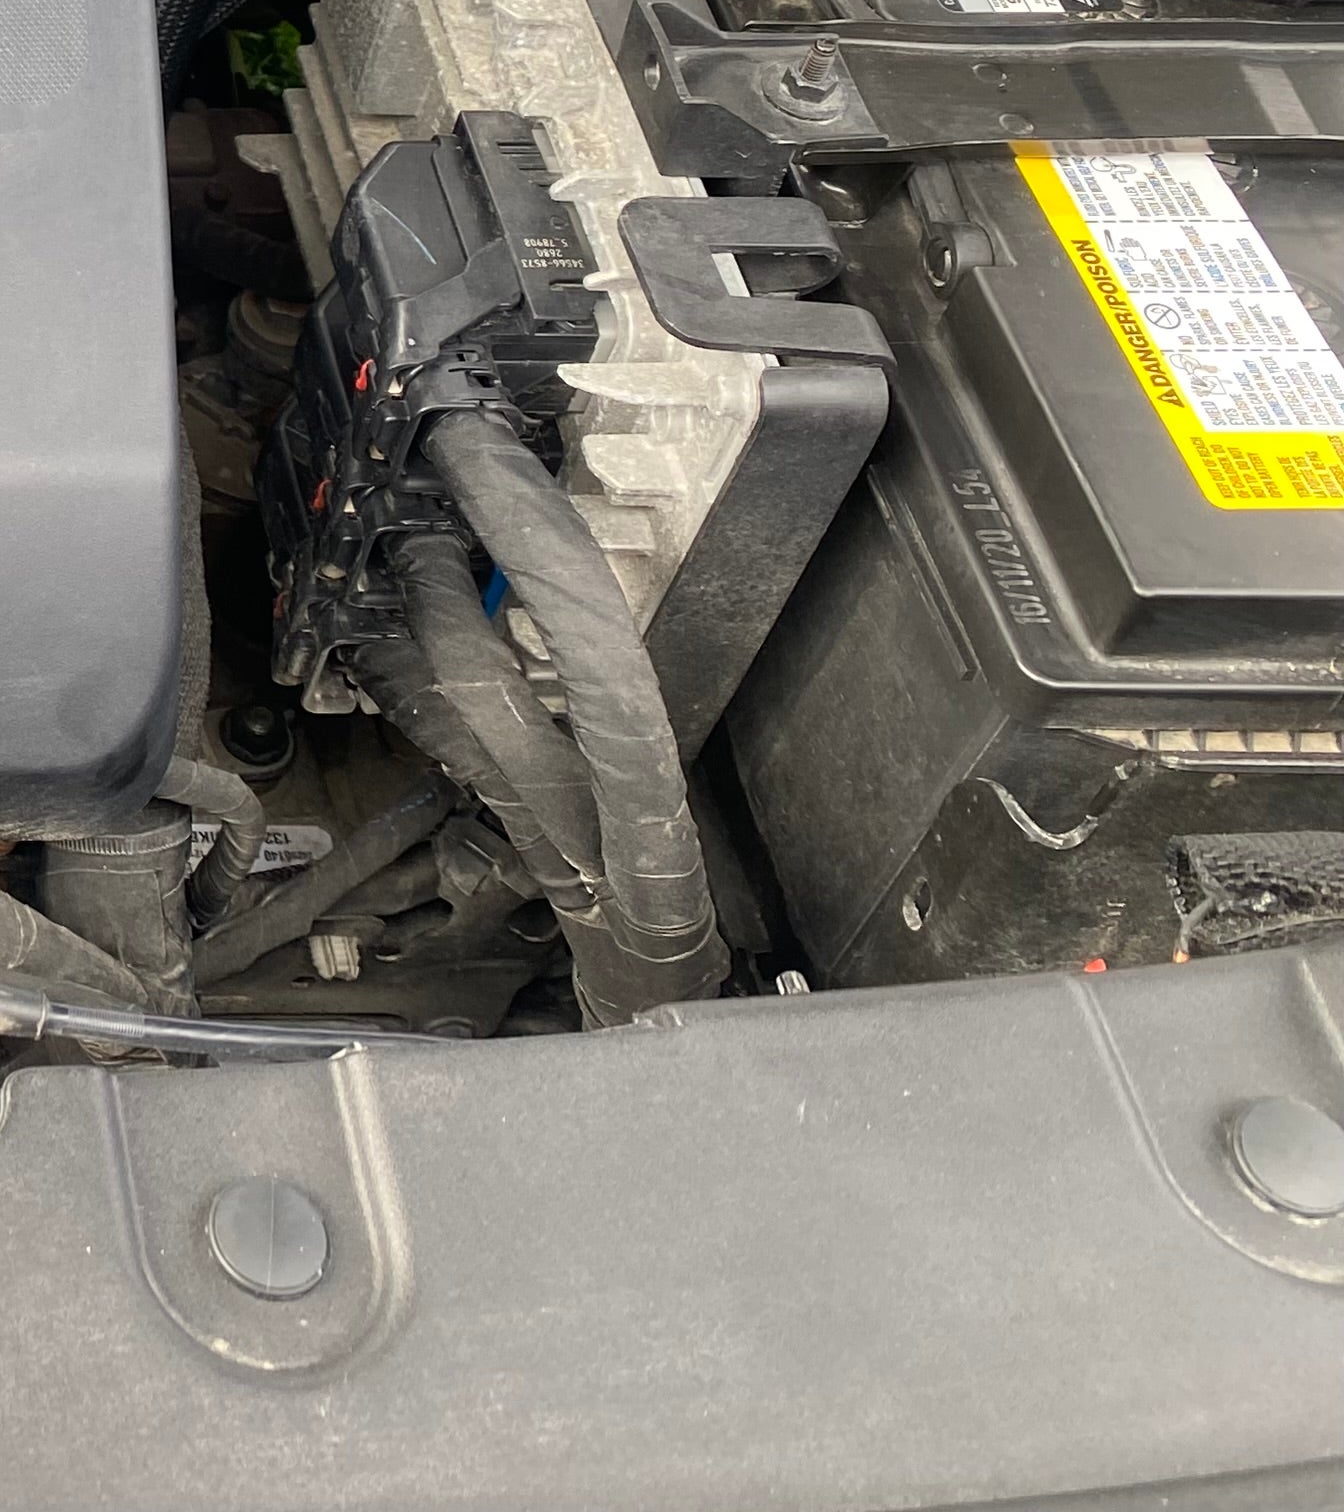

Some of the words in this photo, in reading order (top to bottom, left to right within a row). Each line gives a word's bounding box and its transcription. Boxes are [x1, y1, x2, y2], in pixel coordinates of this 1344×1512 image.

[1124, 187, 1137, 196] LES
[1148, 203, 1164, 215] YEUX
[1150, 258, 1168, 276] CAUSE
[1141, 273, 1160, 287] ACID
[1162, 276, 1176, 287] CAN
[1071, 240, 1172, 386] DANGER/POISON
[1174, 297, 1195, 319] FLAMES
[1250, 335, 1265, 344] LES
[1266, 335, 1282, 344] LES
[1260, 356, 1280, 373] YEUX
[1233, 372, 1254, 391] CAUSE
[1272, 376, 1290, 388] LES
[1246, 393, 1262, 404] CAN
[1201, 401, 1227, 426] SHIELD
[1223, 409, 1244, 425] EYES
[1254, 406, 1275, 425] GASES
[1312, 415, 1330, 425] LES
